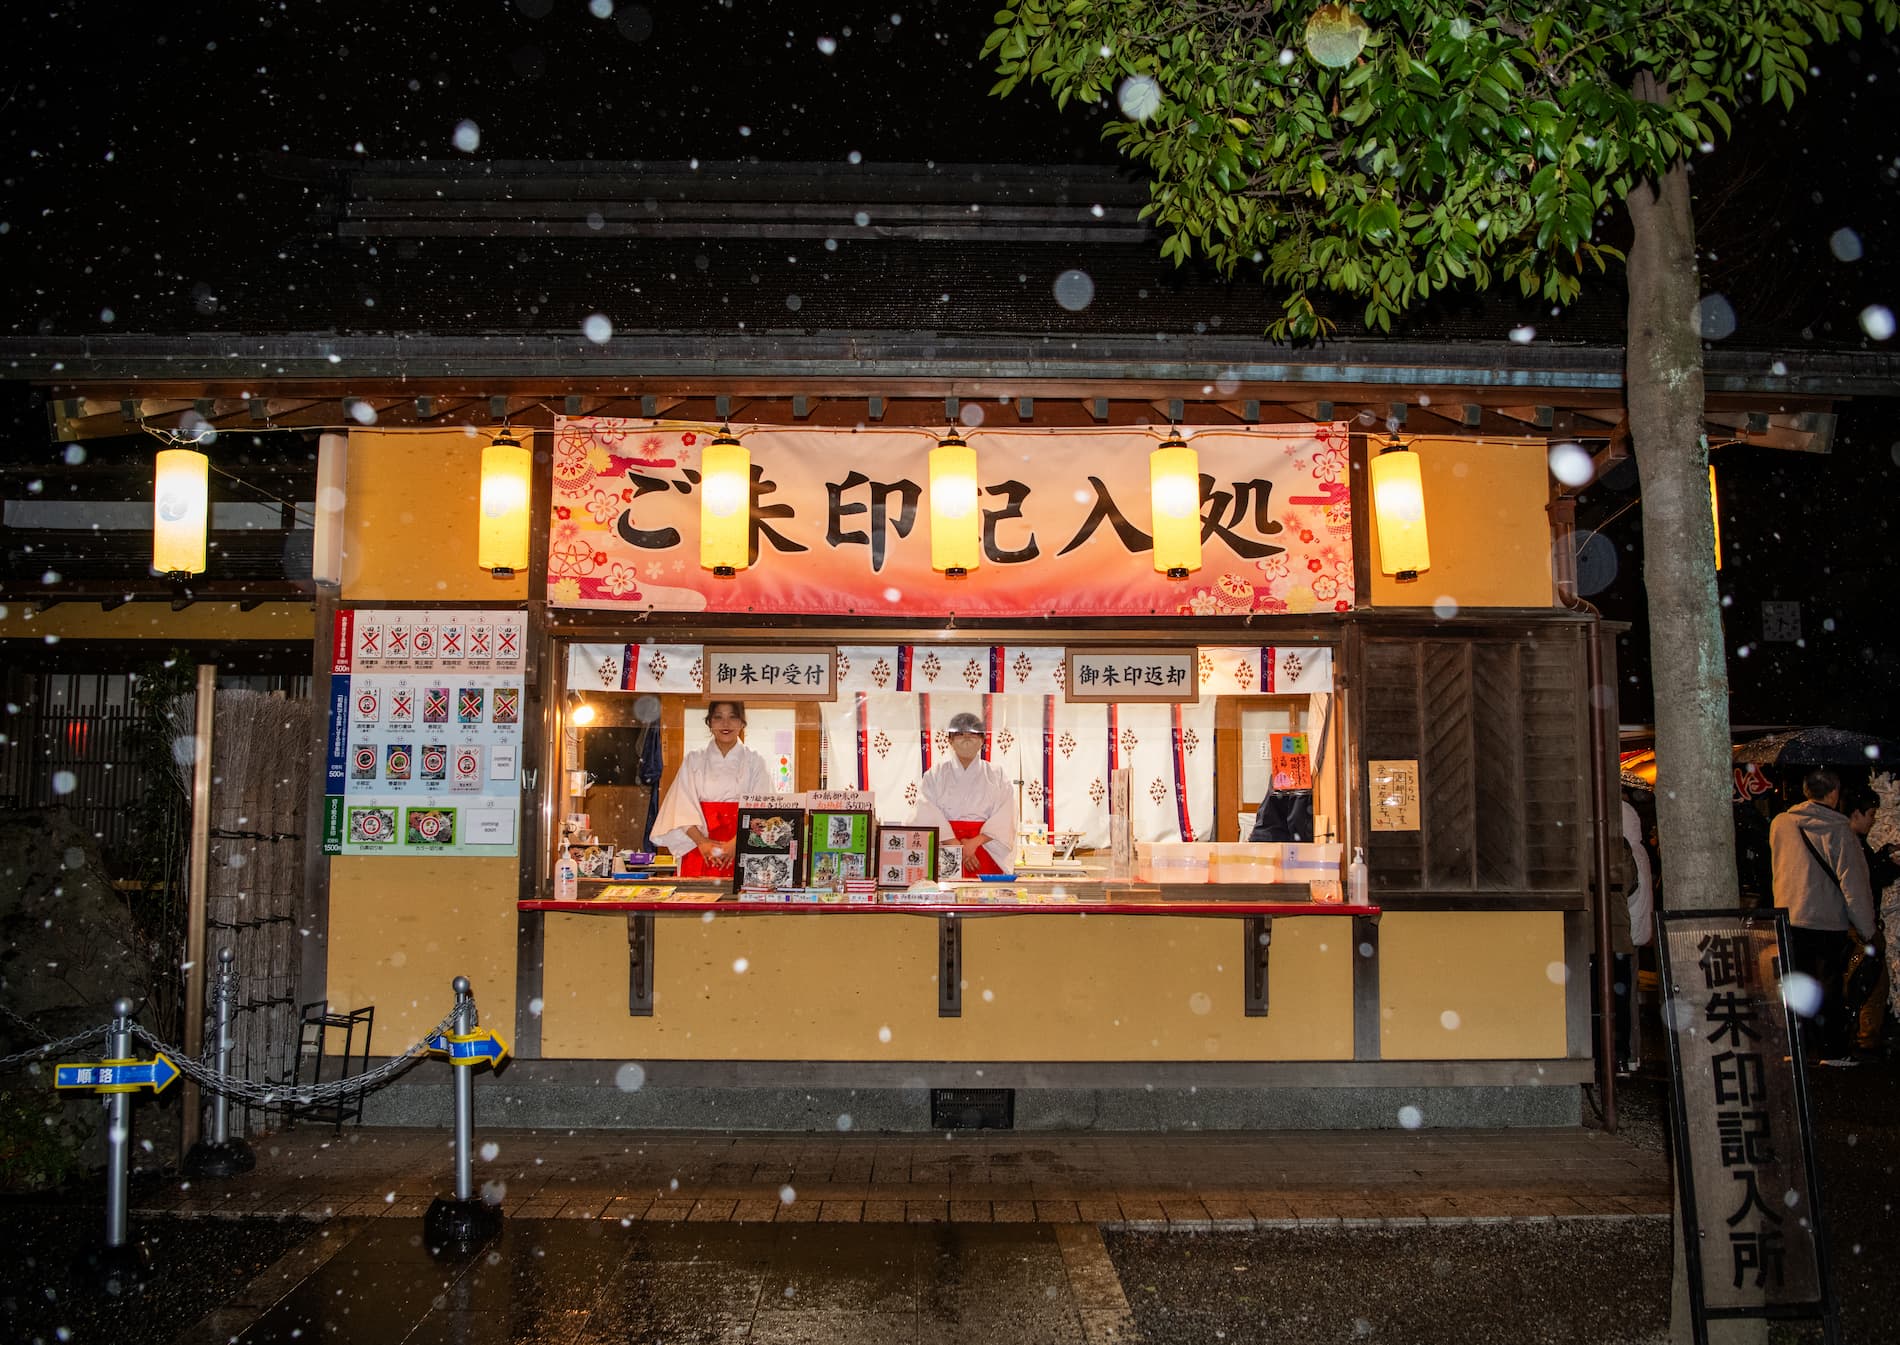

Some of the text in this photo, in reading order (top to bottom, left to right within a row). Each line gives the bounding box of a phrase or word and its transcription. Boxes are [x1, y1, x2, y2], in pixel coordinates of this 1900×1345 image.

[717, 662, 824, 685] 御朱印受付
[1079, 664, 1186, 687] 御朱印返却
[77, 1068, 112, 1084] 順路
[1697, 933, 1785, 1289] 御朱印記入所
